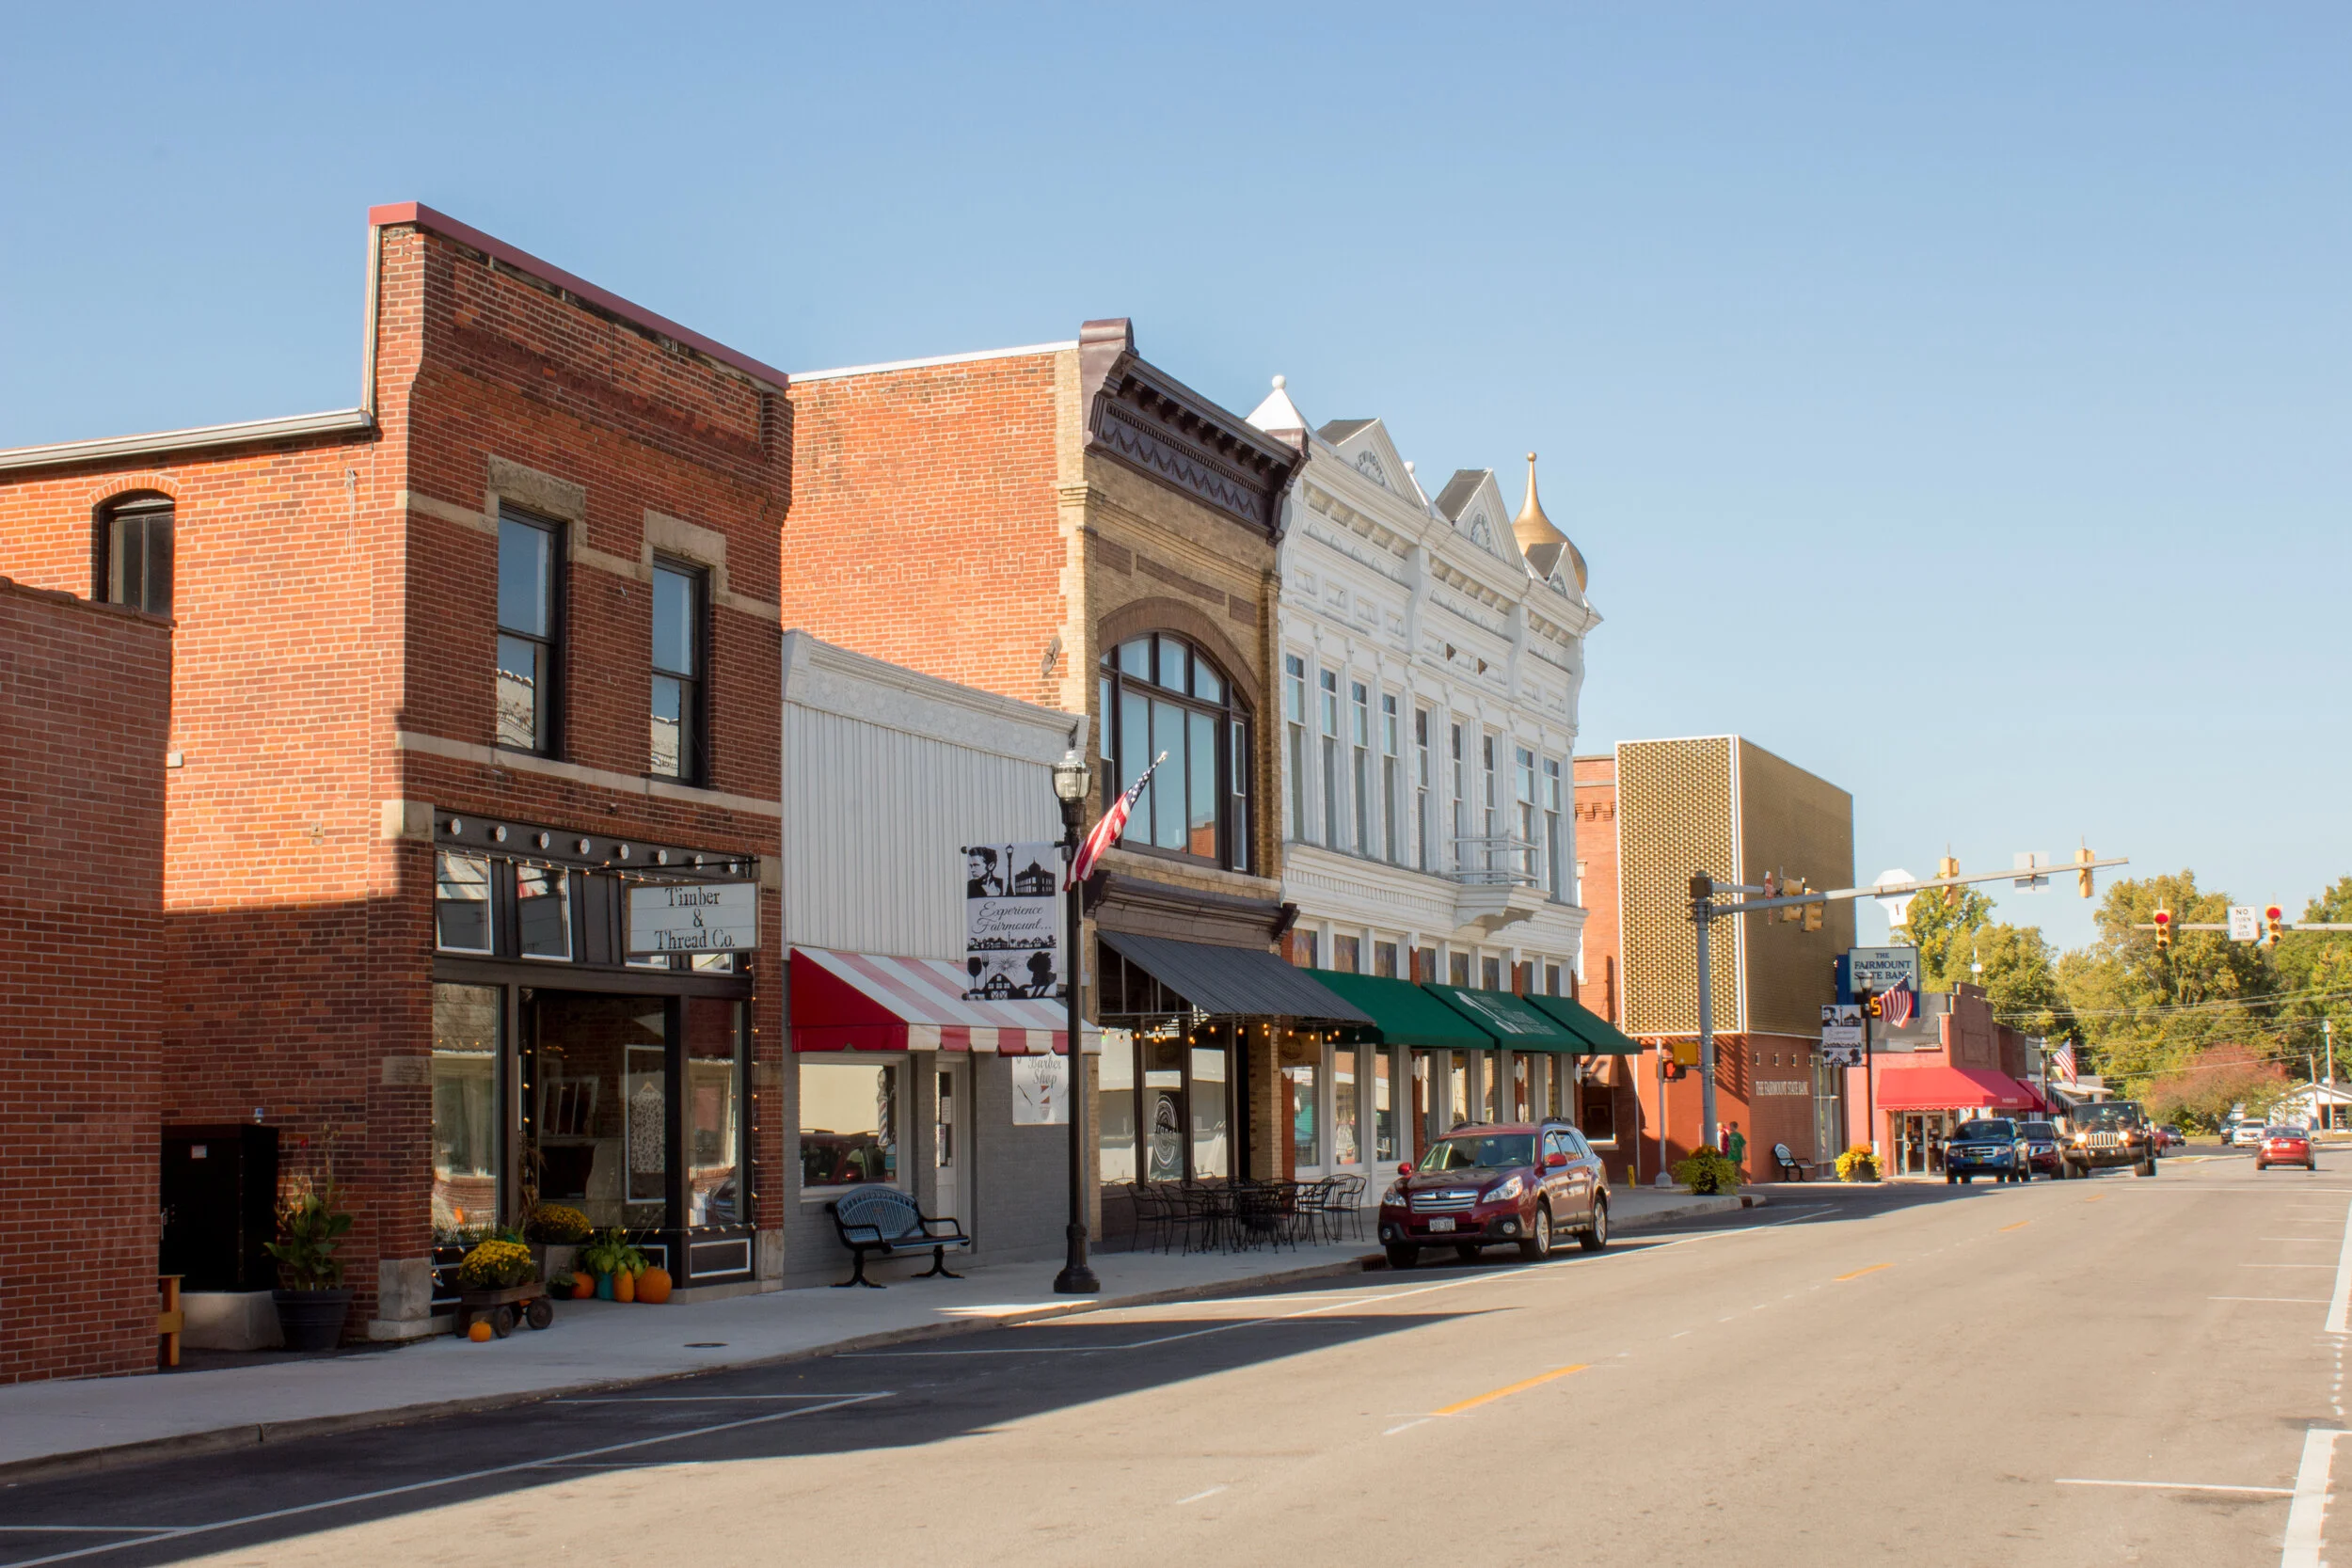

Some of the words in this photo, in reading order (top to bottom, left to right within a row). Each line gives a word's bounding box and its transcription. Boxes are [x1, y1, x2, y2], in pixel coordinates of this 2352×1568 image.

[664, 887, 721, 907] Timber
[692, 908, 704, 927] &
[979, 901, 1043, 920] Experience
[971, 917, 1052, 934] Fairmount...
[654, 929, 707, 950] Thread
[712, 929, 736, 948] Co.
[1854, 960, 1912, 970] FAIRMOUNT
[1033, 1069, 1057, 1089] Shop
